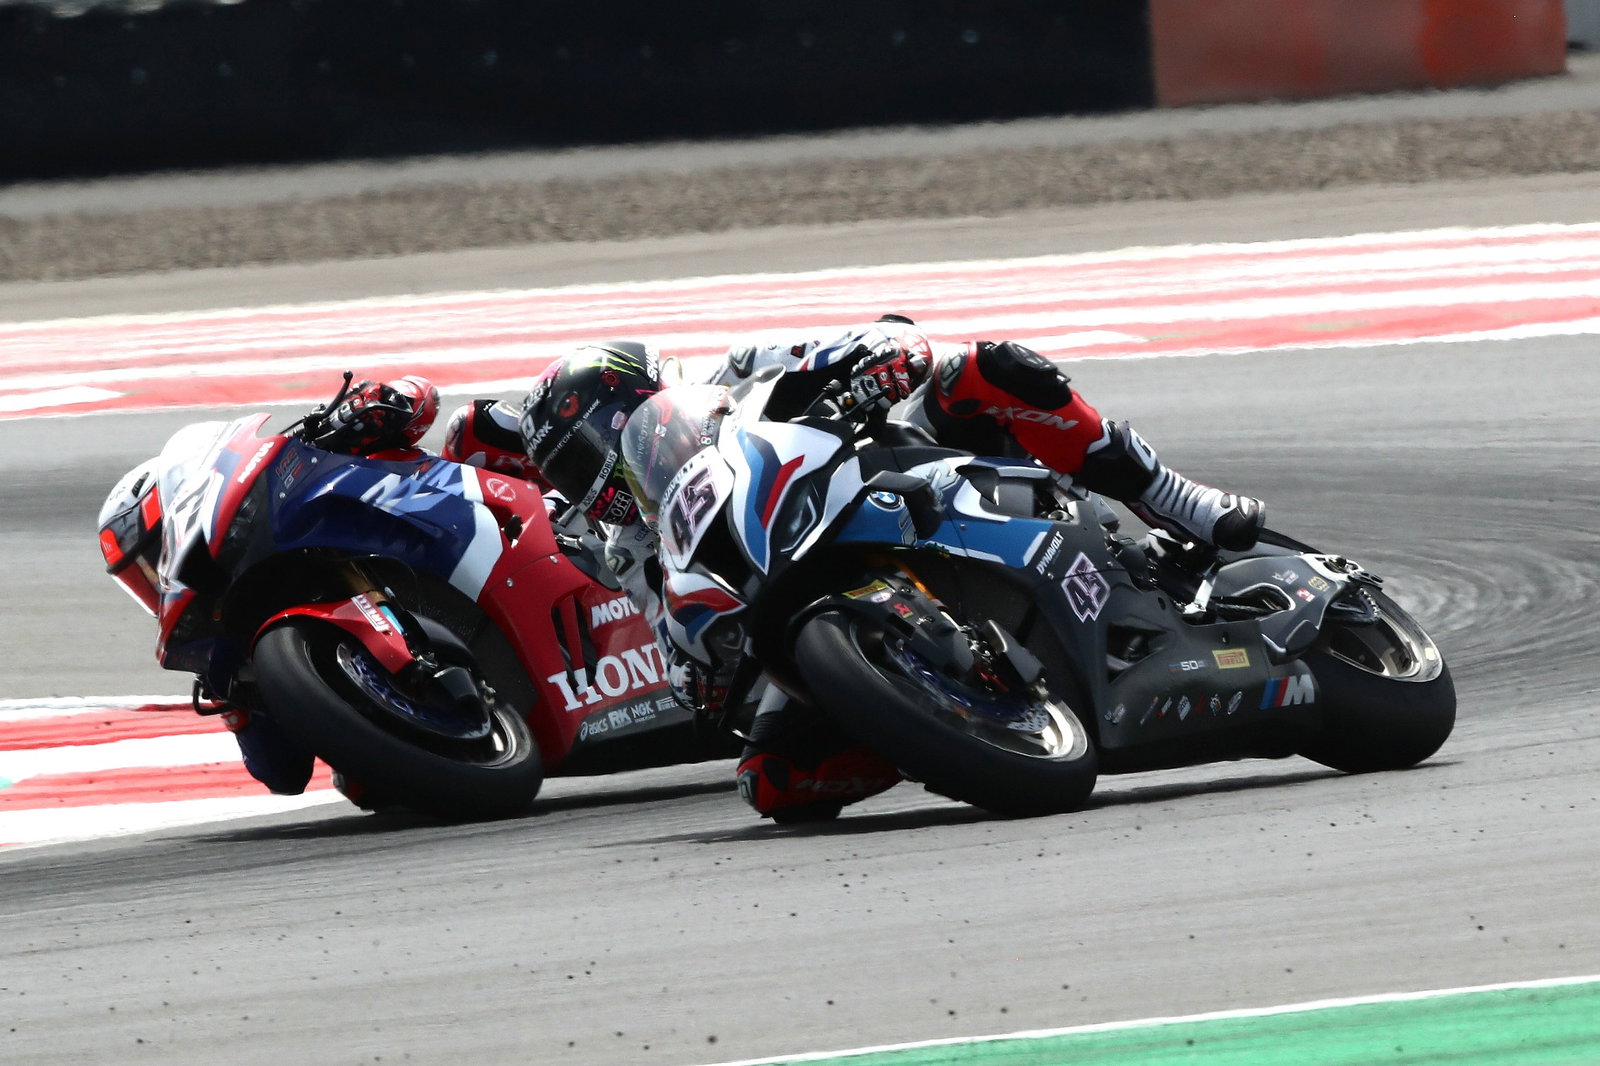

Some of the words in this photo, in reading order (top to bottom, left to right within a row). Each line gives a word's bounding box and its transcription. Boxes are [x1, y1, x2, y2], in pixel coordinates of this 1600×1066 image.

[1035, 530, 1065, 576] DYNAVOLT
[1061, 551, 1111, 624] 45
[631, 701, 654, 718] NGK
[655, 696, 679, 711] PIREL
[1280, 673, 1315, 707] M
